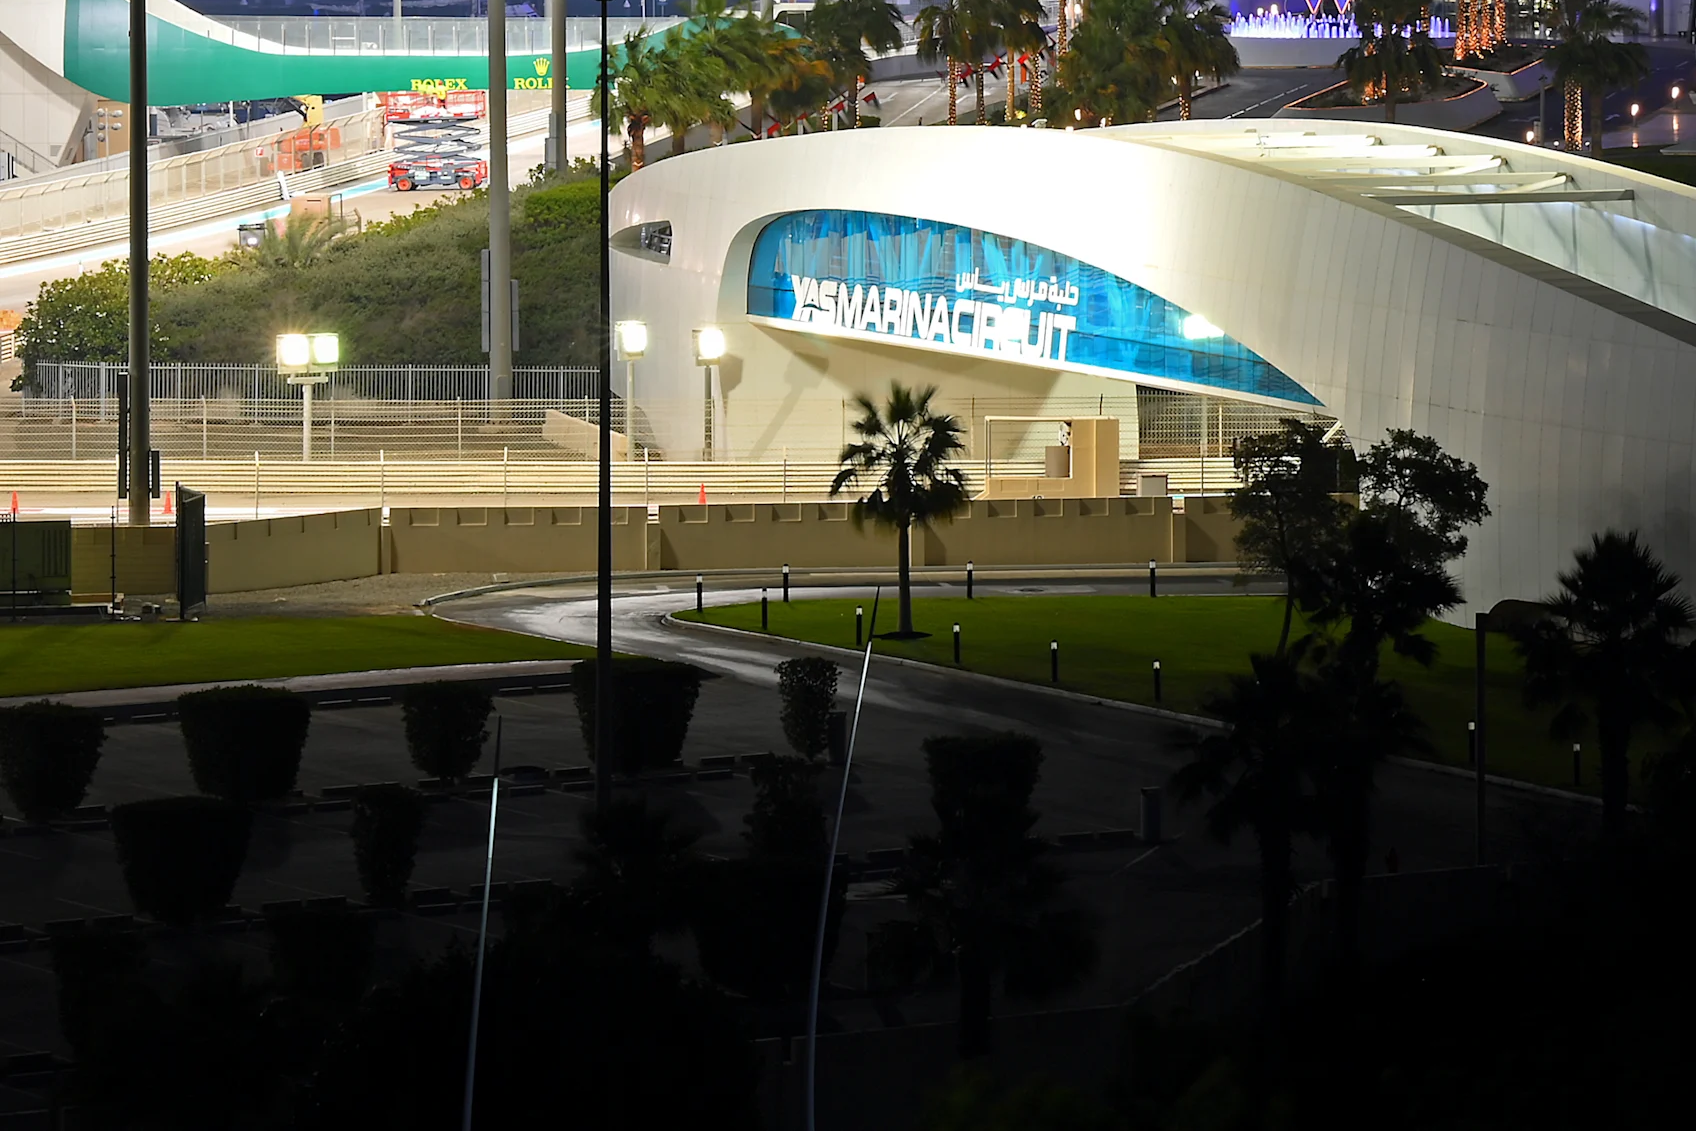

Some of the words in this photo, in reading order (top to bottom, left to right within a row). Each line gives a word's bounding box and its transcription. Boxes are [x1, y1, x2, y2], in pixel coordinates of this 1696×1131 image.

[791, 274, 837, 324] YAS
[836, 282, 955, 345] MARINA
[1048, 276, 1080, 311] حلبة
